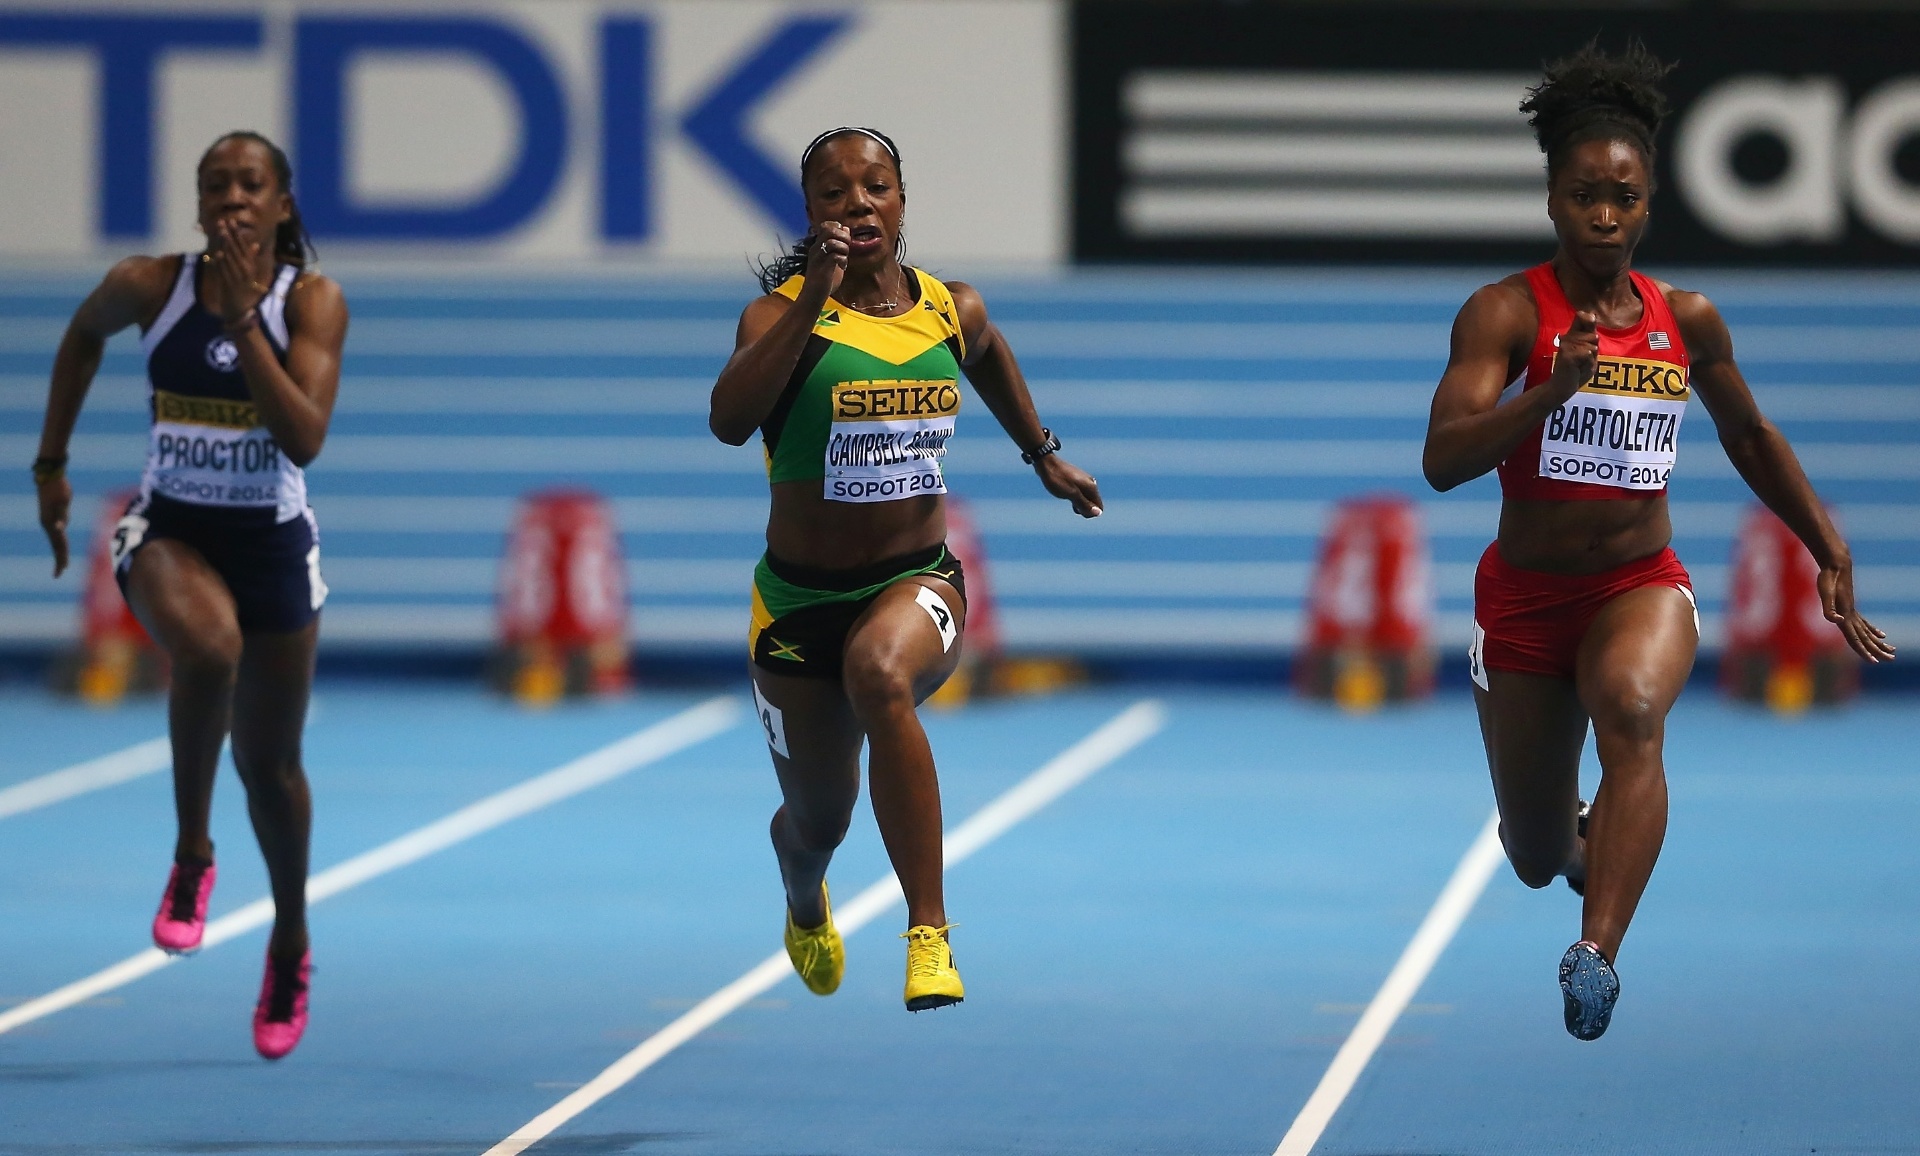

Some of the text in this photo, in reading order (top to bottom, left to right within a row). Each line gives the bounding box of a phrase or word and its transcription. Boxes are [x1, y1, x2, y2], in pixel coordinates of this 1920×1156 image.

[0, 12, 862, 246] TDK
[1588, 361, 1687, 396] EIKO
[163, 395, 258, 427] SEIK
[838, 385, 958, 418] SEIKO
[1548, 404, 1676, 453] BARTOLETTA
[158, 433, 278, 474] PROCTOR
[829, 428, 952, 467] CAMPBELL-BROWN
[158, 474, 224, 499] SOPOT
[833, 473, 943, 498] SOPOT 201
[1549, 457, 1671, 485] SOPOT 2014
[931, 604, 950, 633] 4
[762, 708, 778, 745] 4
